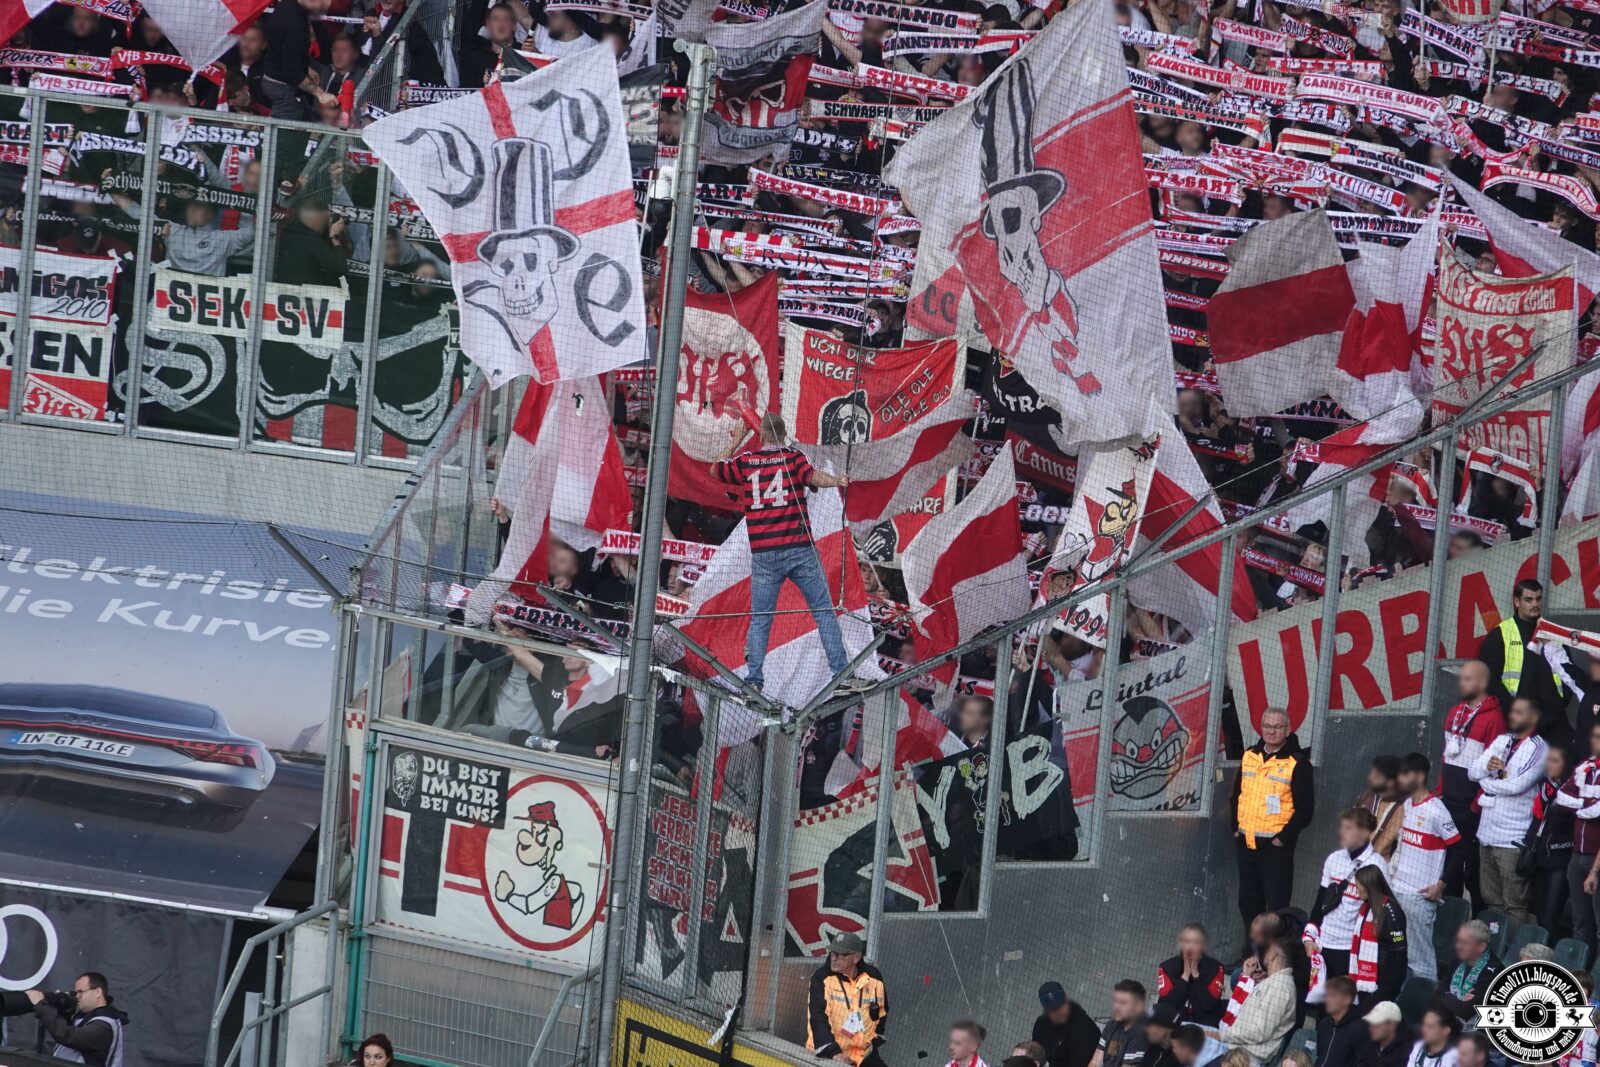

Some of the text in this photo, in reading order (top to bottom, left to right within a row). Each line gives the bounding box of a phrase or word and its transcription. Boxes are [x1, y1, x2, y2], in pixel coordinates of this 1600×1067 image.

[118, 51, 141, 64] VfB
[1147, 54, 1287, 96] CANNSTATTER KURVE
[1303, 77, 1396, 100] CANNSTATTER
[824, 102, 893, 119] SCHWABEN
[48, 297, 108, 319] 2010
[168, 279, 329, 338] SEK SV
[809, 335, 842, 356] VON
[747, 468, 789, 510] 14
[20, 733, 45, 744] IN
[54, 735, 80, 746] GT
[421, 755, 502, 786] DU BIST
[420, 774, 500, 808] IMMER
[419, 794, 500, 823] BEI UNS!
